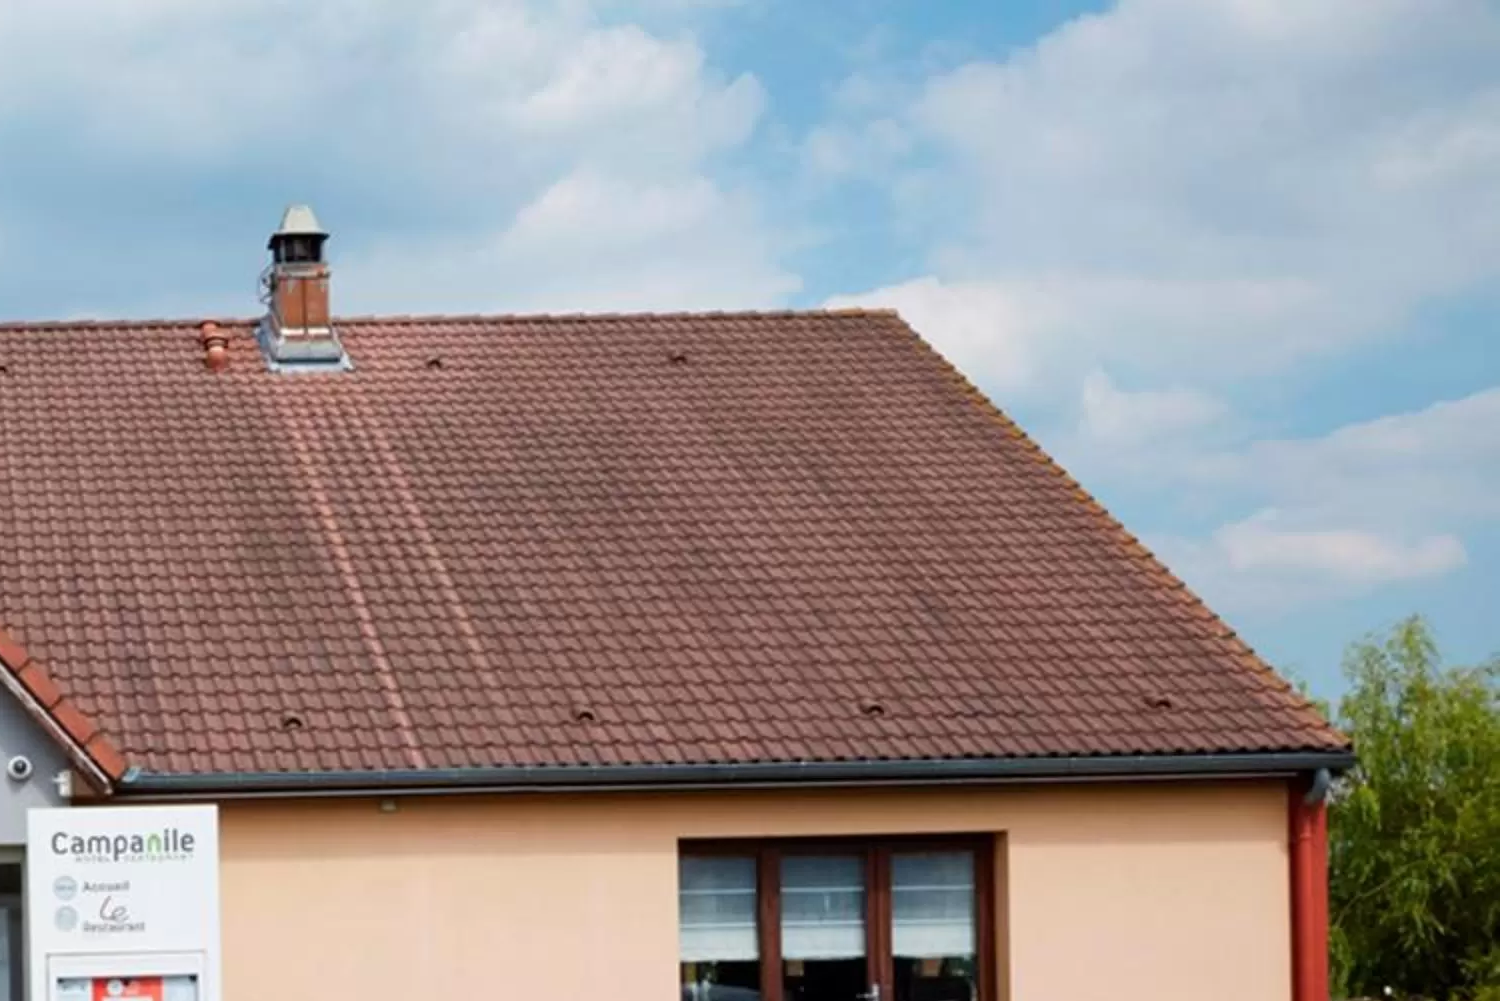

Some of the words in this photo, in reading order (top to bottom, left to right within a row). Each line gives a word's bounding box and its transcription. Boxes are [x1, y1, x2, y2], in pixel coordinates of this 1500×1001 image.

[51, 828, 195, 861] Campanile
[82, 880, 130, 892] Accueil
[82, 921, 146, 933] Restaurant
